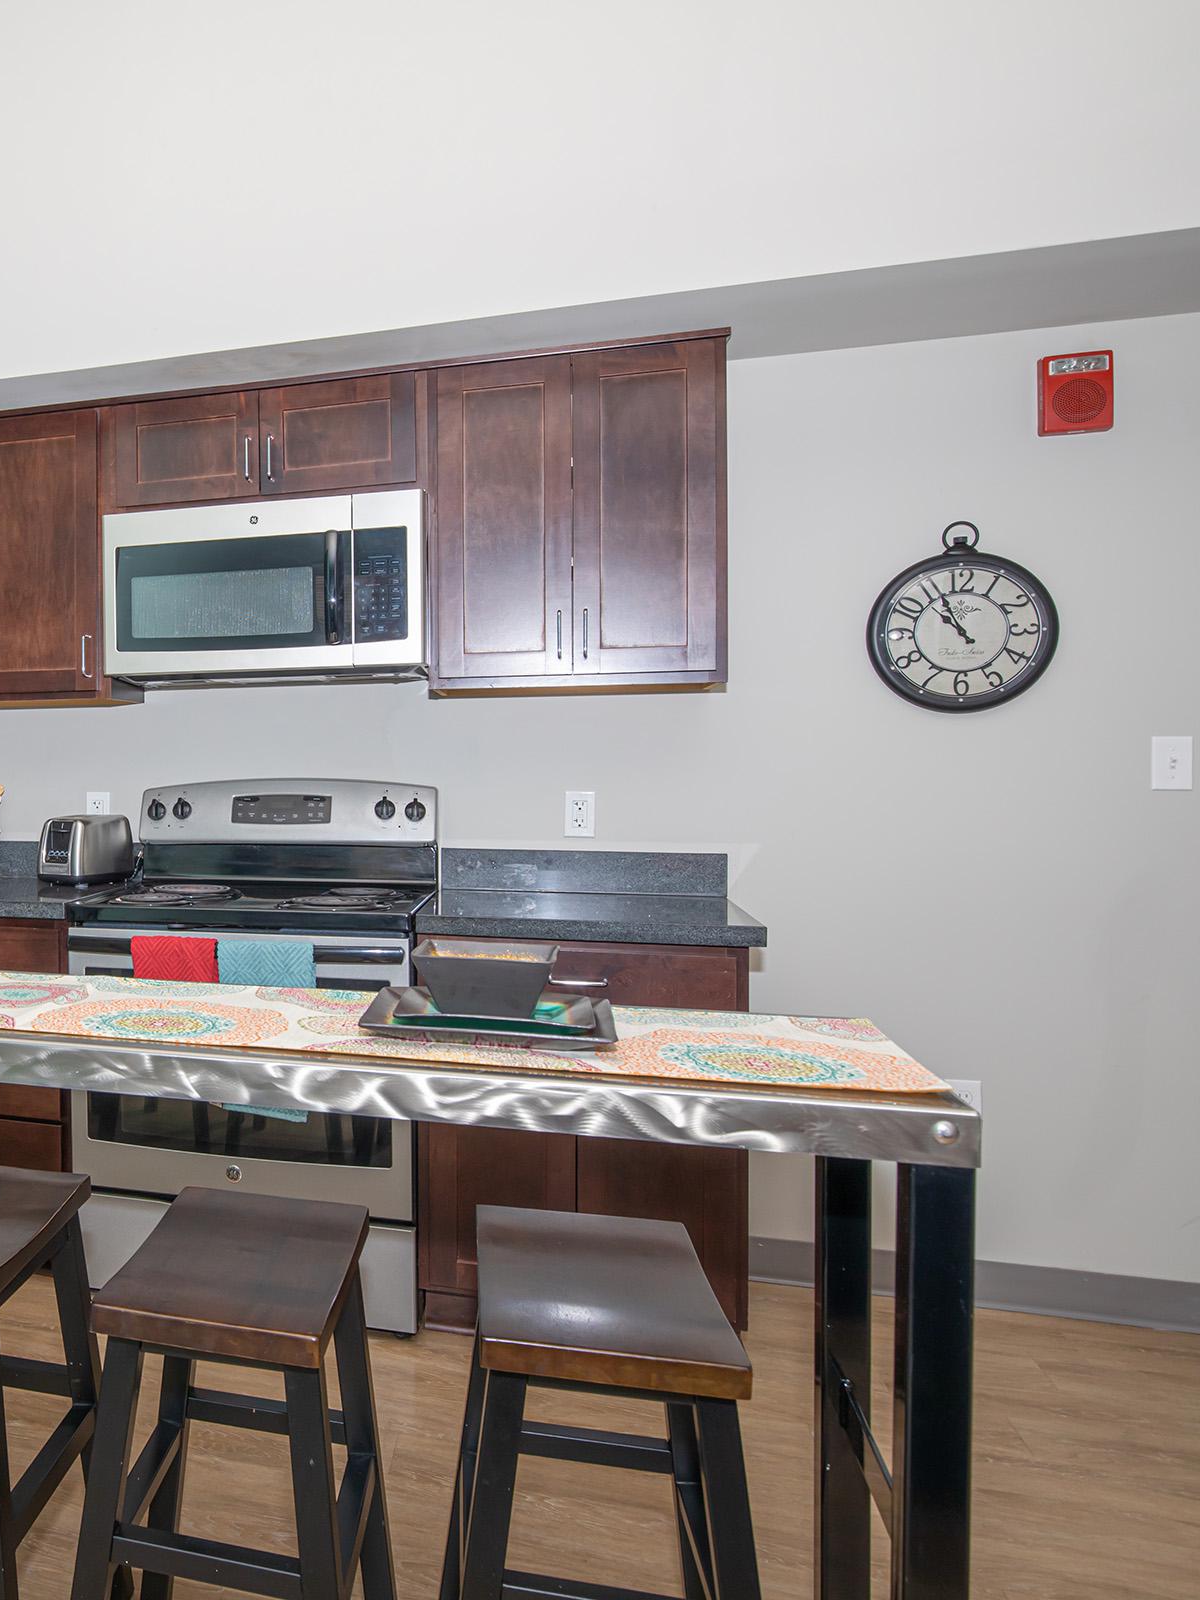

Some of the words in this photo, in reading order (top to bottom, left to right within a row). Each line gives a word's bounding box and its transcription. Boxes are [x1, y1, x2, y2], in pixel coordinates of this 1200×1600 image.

[917, 576, 946, 604] 11
[948, 568, 975, 593] 12
[981, 575, 1000, 597] 1
[892, 597, 924, 622] 10
[999, 594, 1030, 615] 2
[888, 627, 915, 641] 9
[1009, 623, 1040, 637] 3
[895, 650, 922, 669] 8
[1004, 646, 1031, 664] 4
[921, 664, 944, 688] 7
[953, 671, 969, 696] 6
[981, 663, 1004, 687] 5
